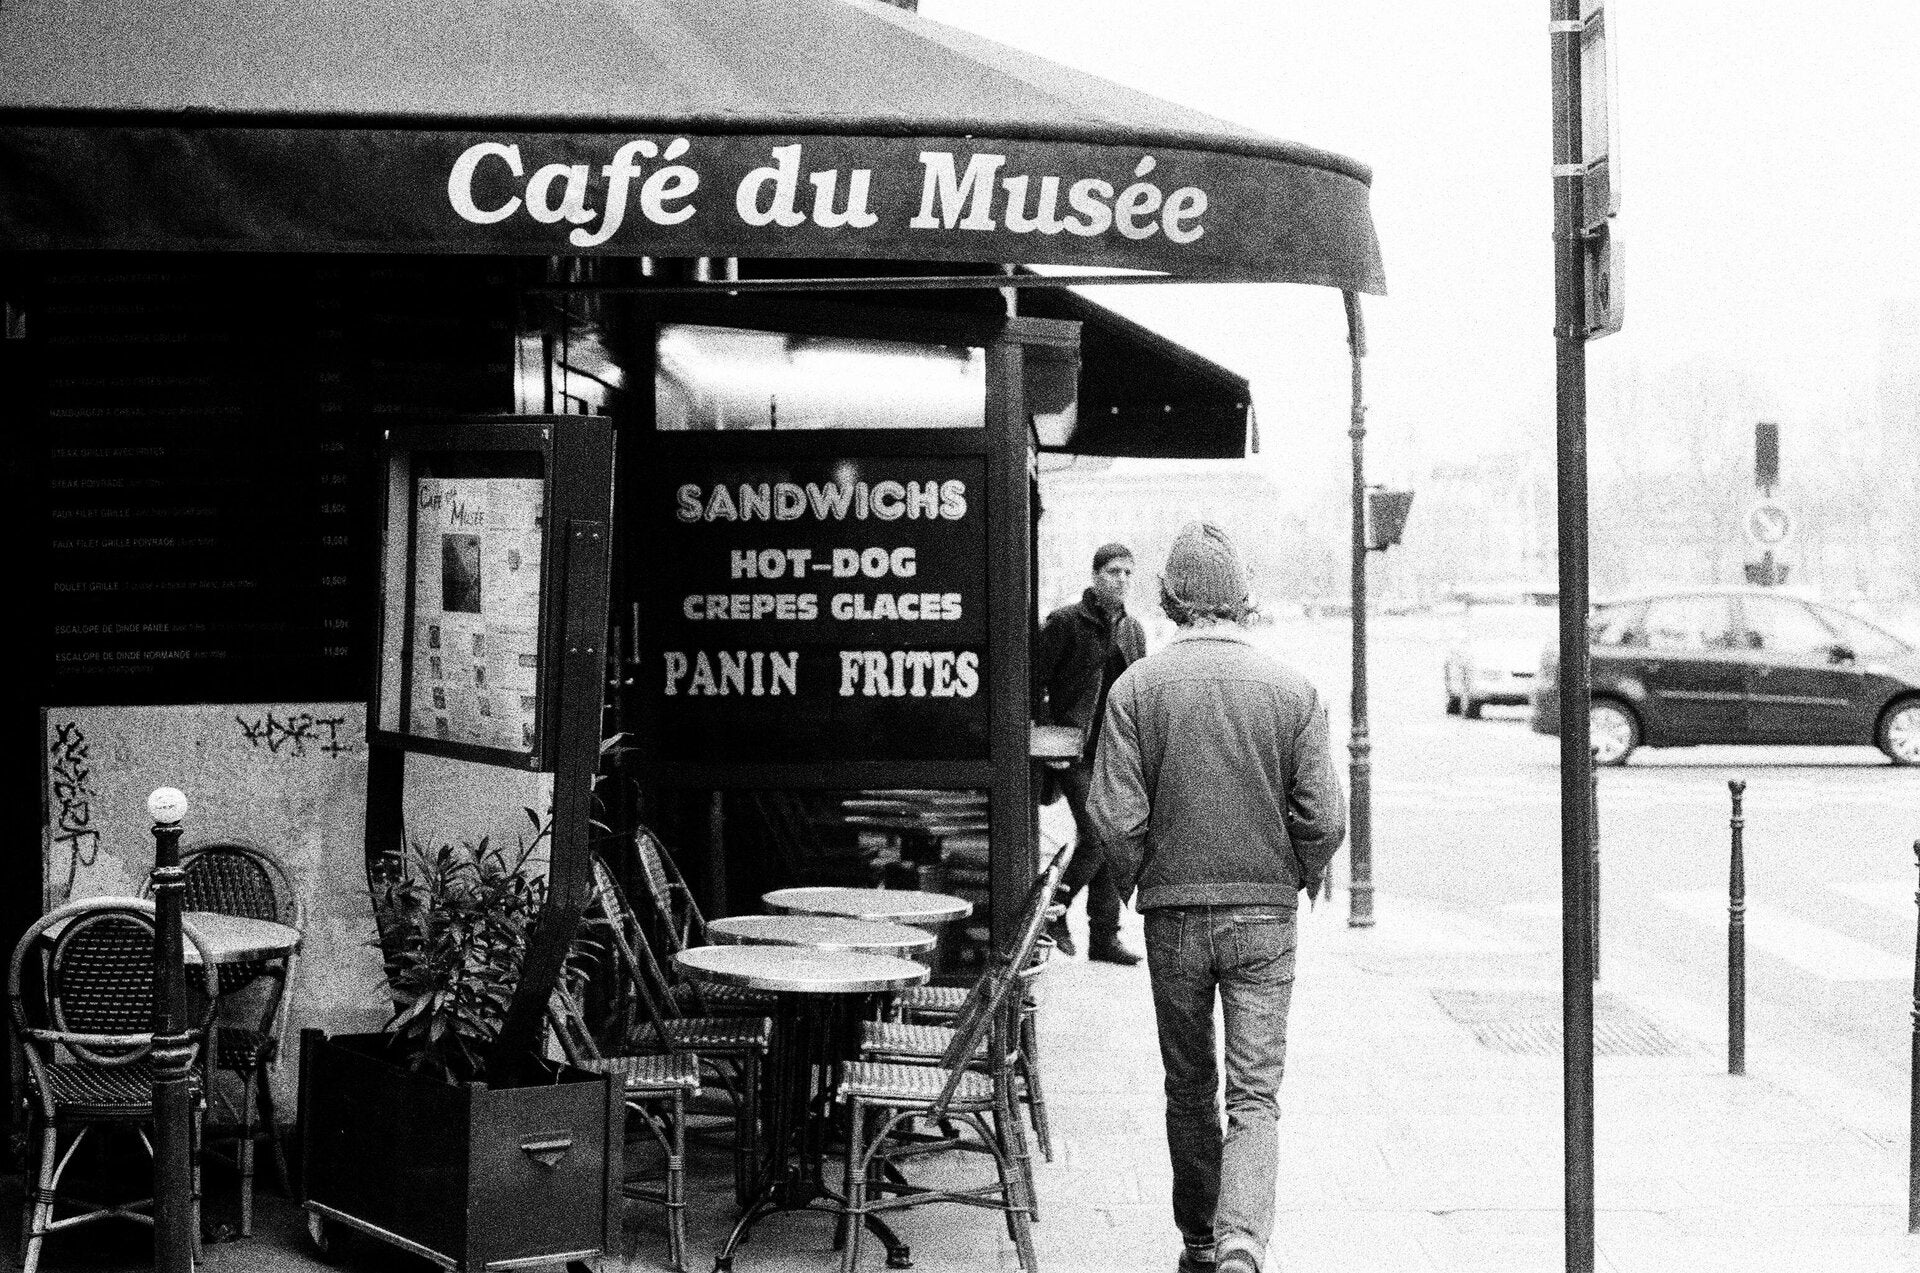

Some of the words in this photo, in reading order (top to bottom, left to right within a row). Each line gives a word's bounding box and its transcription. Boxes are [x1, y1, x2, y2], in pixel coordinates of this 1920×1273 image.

[448, 137, 700, 248] Café
[736, 143, 878, 230] du
[909, 150, 1209, 244] Musée
[676, 480, 967, 522] SANDWICHS
[731, 547, 916, 578] HOT-DOG
[53, 582, 87, 592] POULET
[89, 581, 119, 592] GRILLE
[683, 594, 818, 620] CREPES
[831, 593, 962, 620] GLACES
[55, 624, 100, 635] ESCALOPE
[102, 624, 114, 634] DE
[115, 623, 140, 634] DINDE
[55, 651, 100, 662] ESCALOPE
[102, 651, 115, 661] DE
[116, 650, 141, 661] DINDE
[143, 649, 191, 660] NORMANDE
[664, 650, 799, 696] PANIN
[839, 650, 980, 698] FRITES
